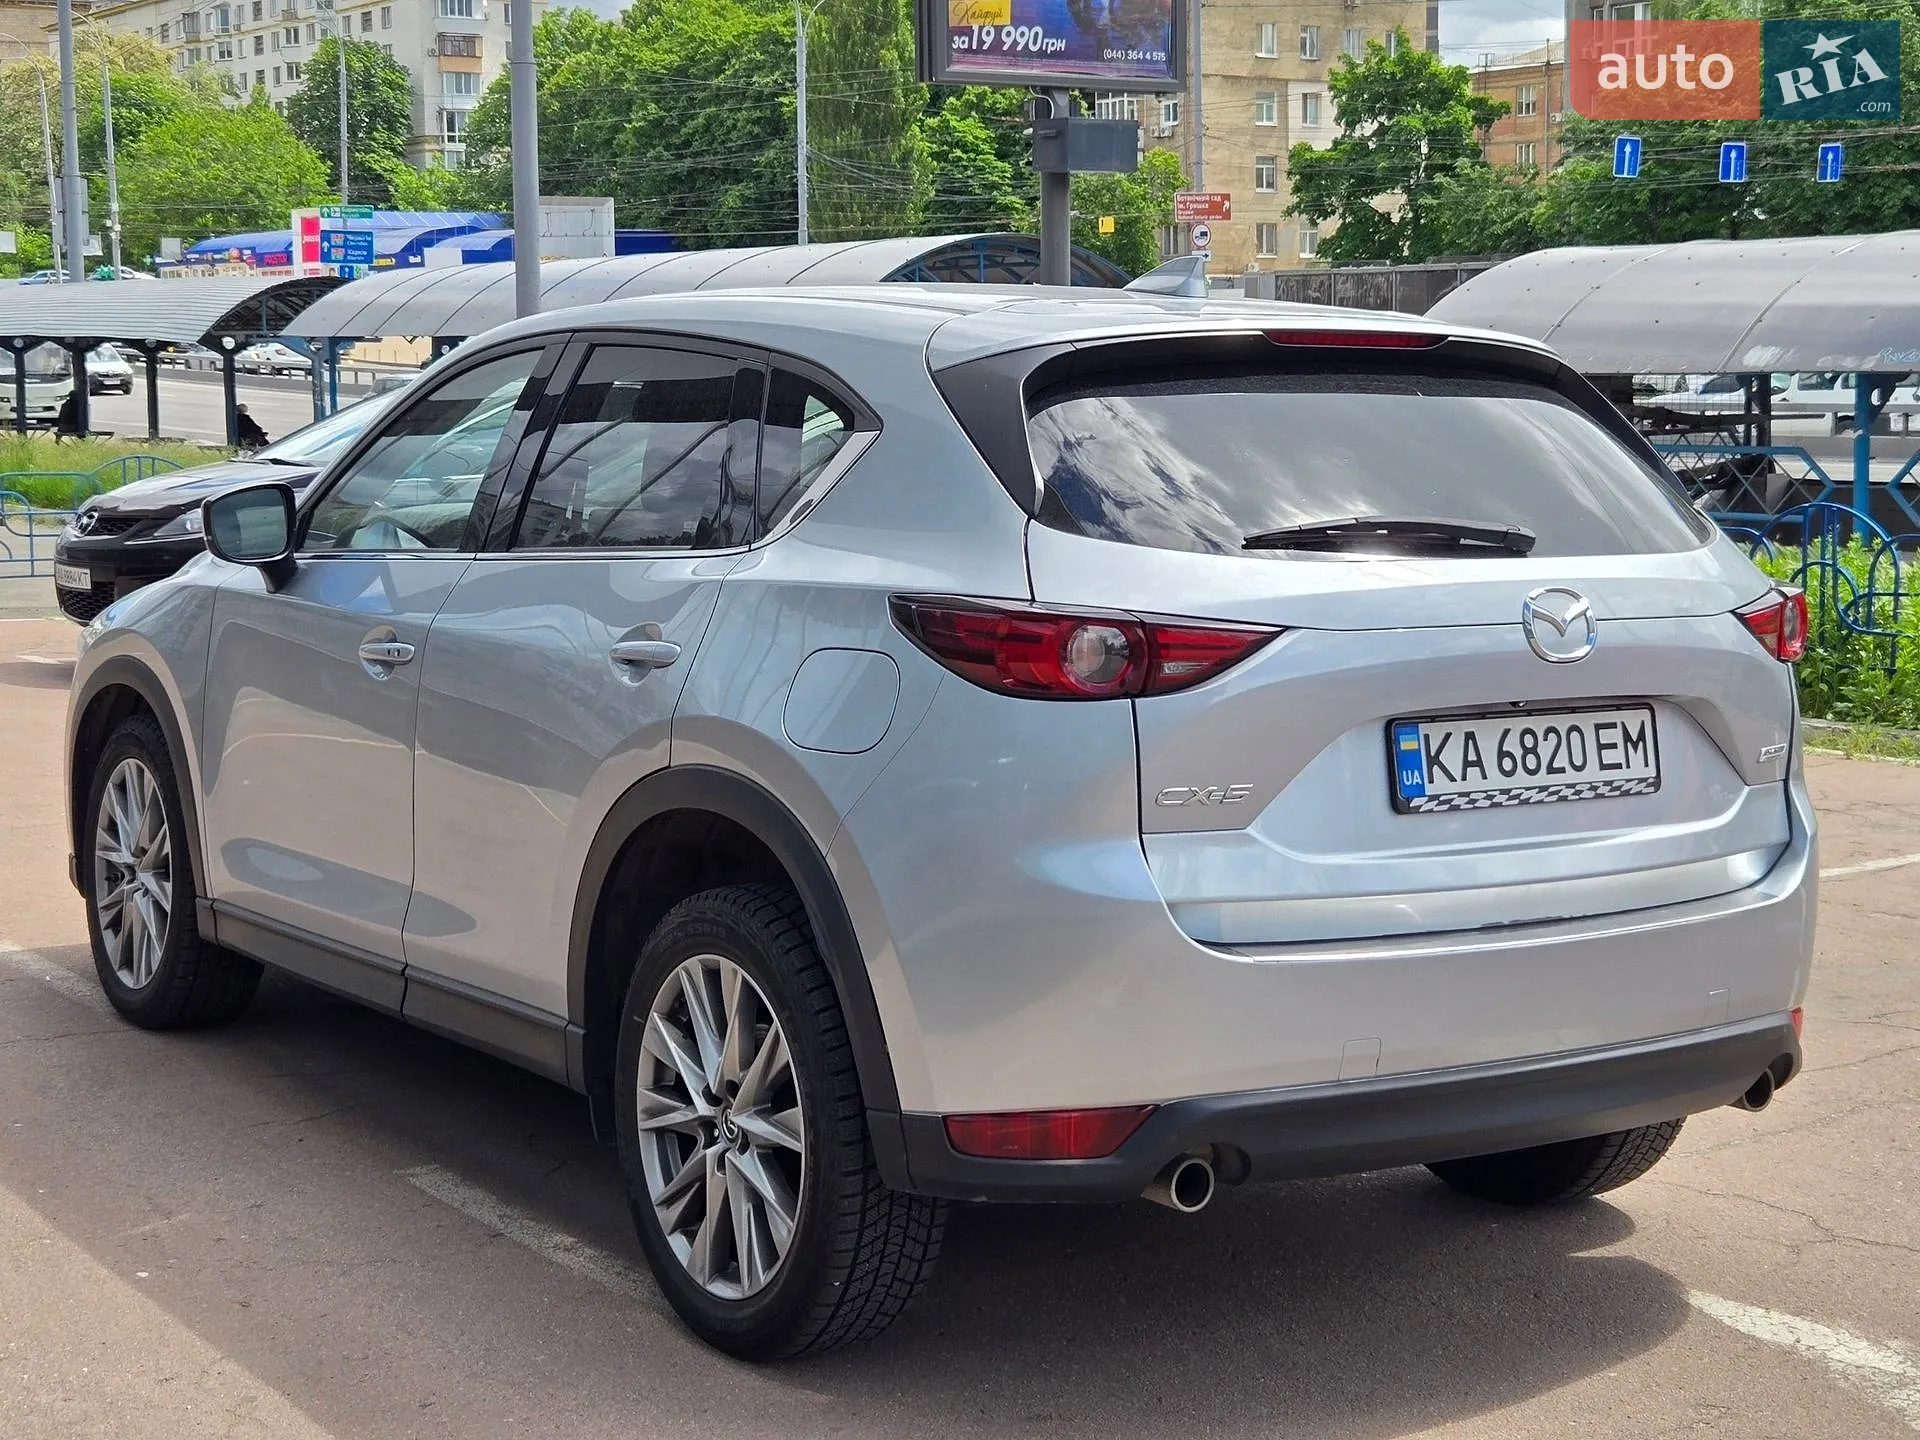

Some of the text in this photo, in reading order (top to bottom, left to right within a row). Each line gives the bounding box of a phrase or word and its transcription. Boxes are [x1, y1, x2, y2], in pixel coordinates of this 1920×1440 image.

[951, 25, 1066, 54] за 19 990 грн
[1103, 48, 1126, 61] (044)
[1423, 719, 1650, 784] KA 6820 EM
[1402, 769, 1423, 786] UA
[1155, 783, 1254, 806] CX-5
